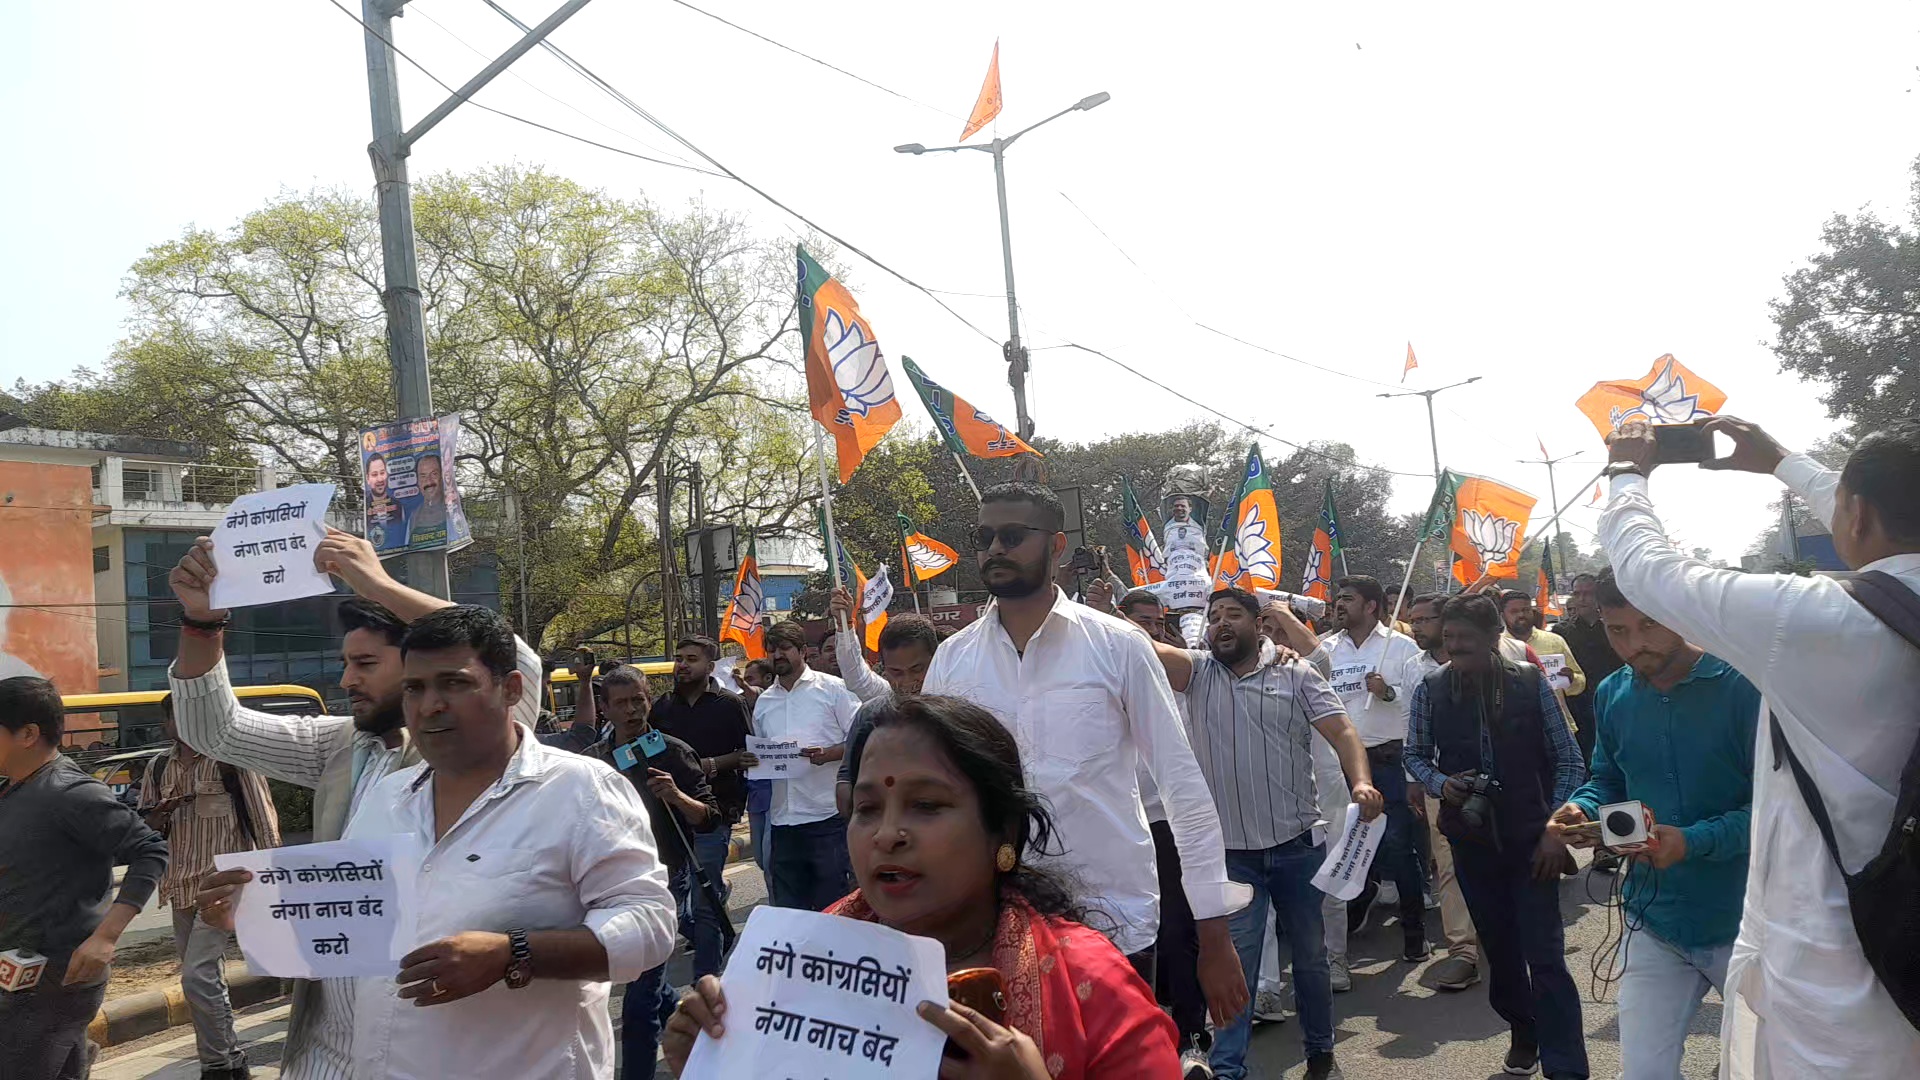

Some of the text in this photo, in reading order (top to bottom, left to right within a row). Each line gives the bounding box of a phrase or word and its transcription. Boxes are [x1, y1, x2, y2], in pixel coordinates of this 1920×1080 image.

[226, 510, 249, 529] नंगे
[233, 532, 307, 559] नंगा नाच बंद
[262, 565, 285, 585] करो
[1188, 591, 1203, 599] करो
[1330, 669, 1344, 680] हुल
[1546, 673, 1557, 682] रो
[774, 763, 787, 771] करो
[257, 866, 292, 885] नंगे
[269, 895, 384, 921] नंगा नाच बंद
[312, 932, 349, 955] करो
[756, 940, 797, 979] नंगे
[755, 1000, 900, 1067] नंगा नाच बंद
